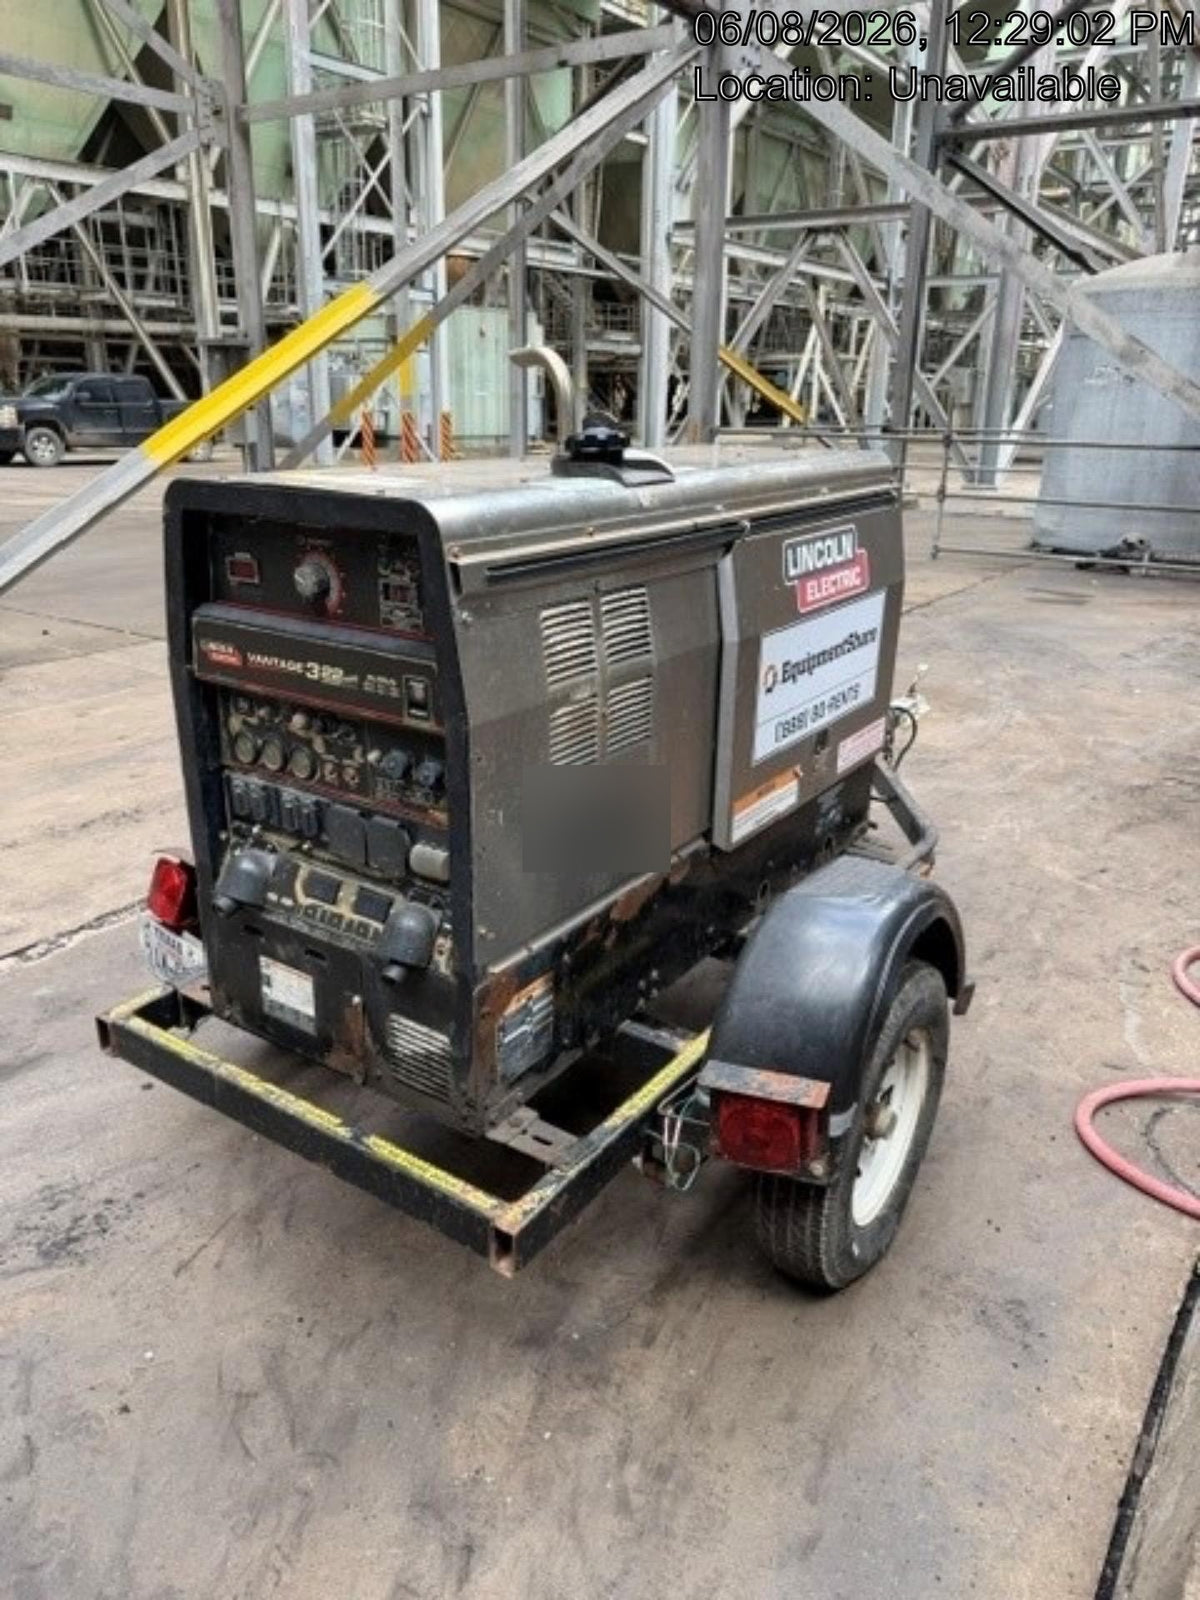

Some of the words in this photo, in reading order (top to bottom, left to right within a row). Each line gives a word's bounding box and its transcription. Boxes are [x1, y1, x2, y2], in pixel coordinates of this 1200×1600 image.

[786, 532, 853, 578] LINCOLN
[806, 565, 861, 603] ELECTRIC
[246, 651, 303, 673] VANTAGE
[781, 627, 878, 684] EquipmentShare
